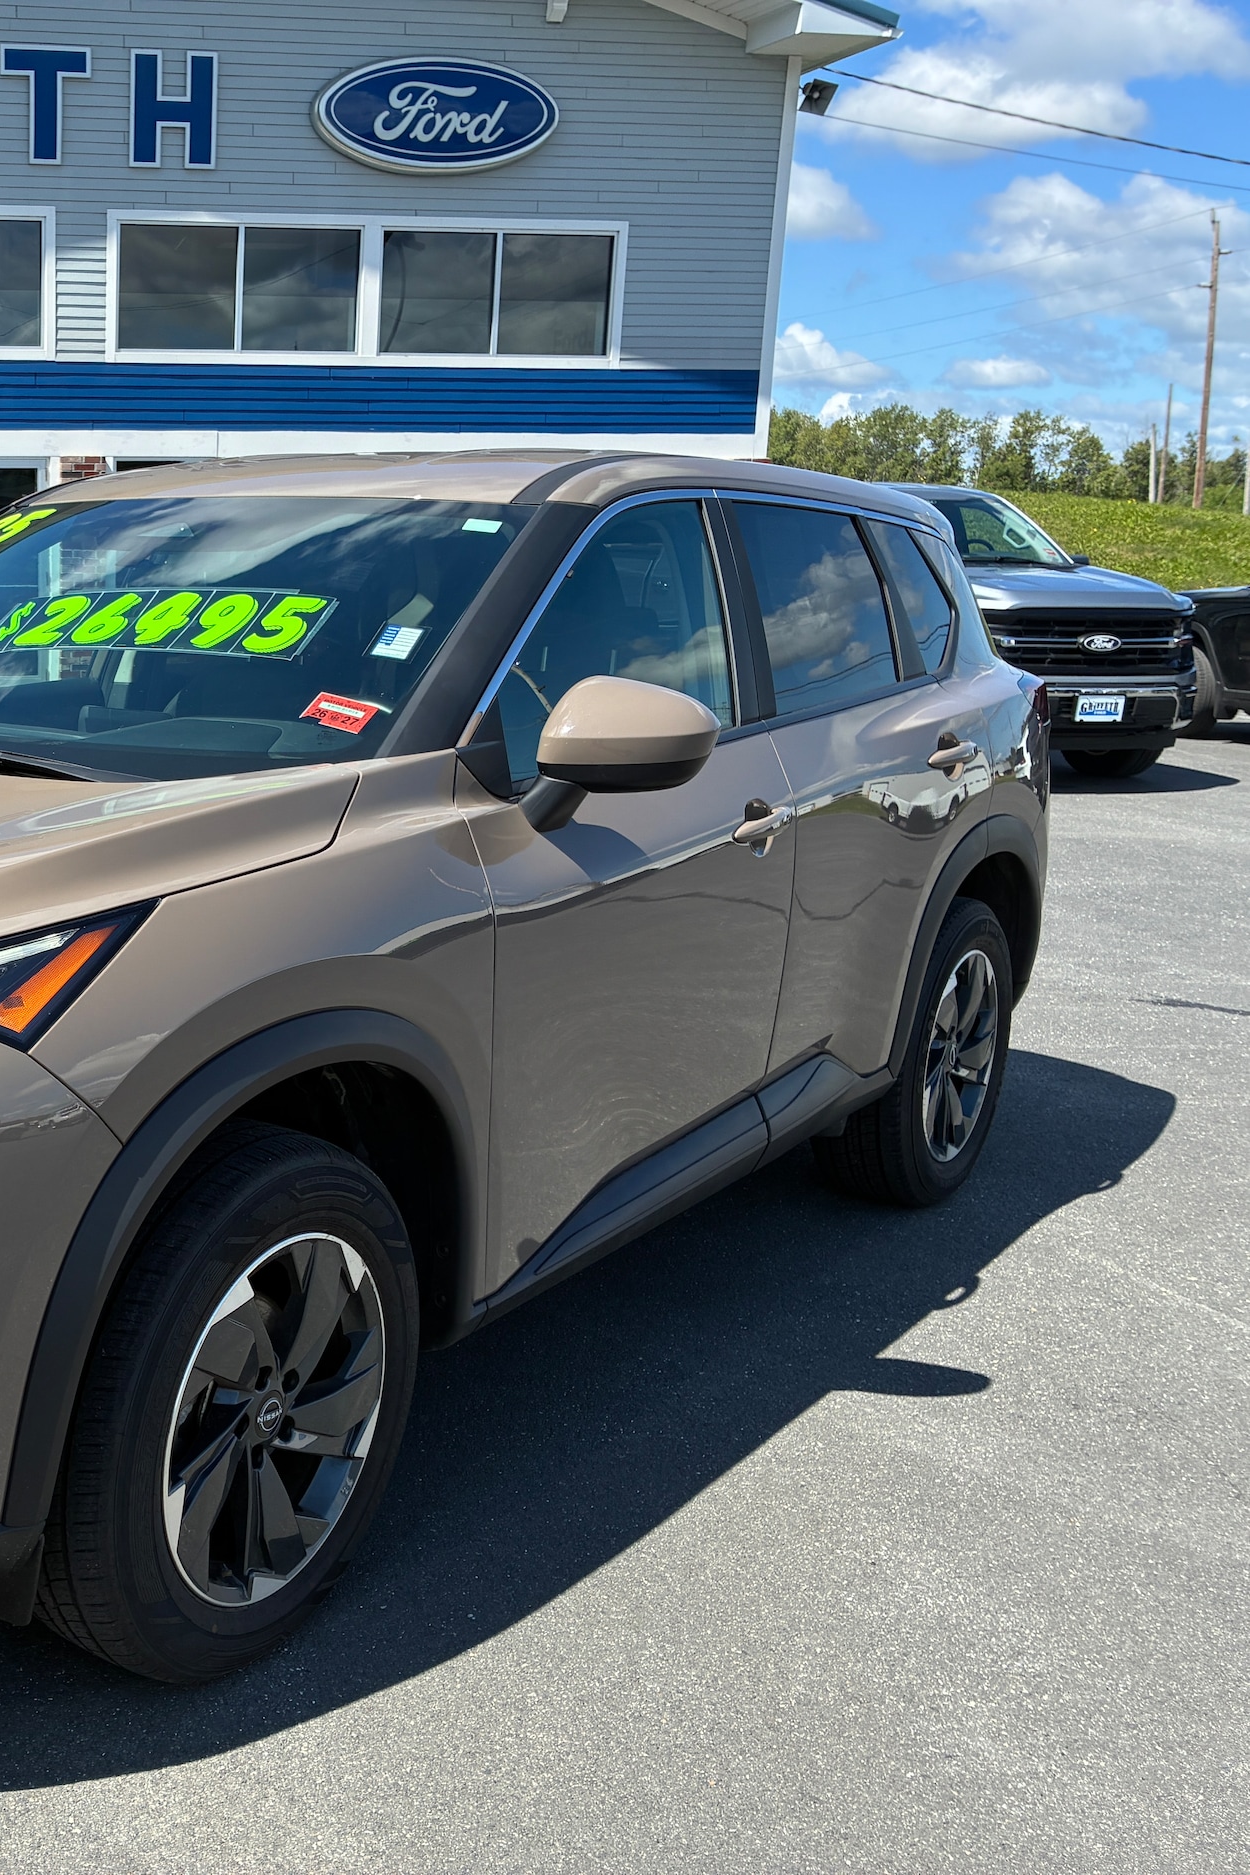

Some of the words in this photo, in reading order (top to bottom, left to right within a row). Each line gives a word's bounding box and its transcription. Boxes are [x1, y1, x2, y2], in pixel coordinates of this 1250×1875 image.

[373, 81, 510, 144] Ford
[1090, 637, 1115, 648] Ford
[311, 708, 329, 718] 26
[341, 716, 360, 726] 27
[257, 1408, 283, 1423] NISSAN
